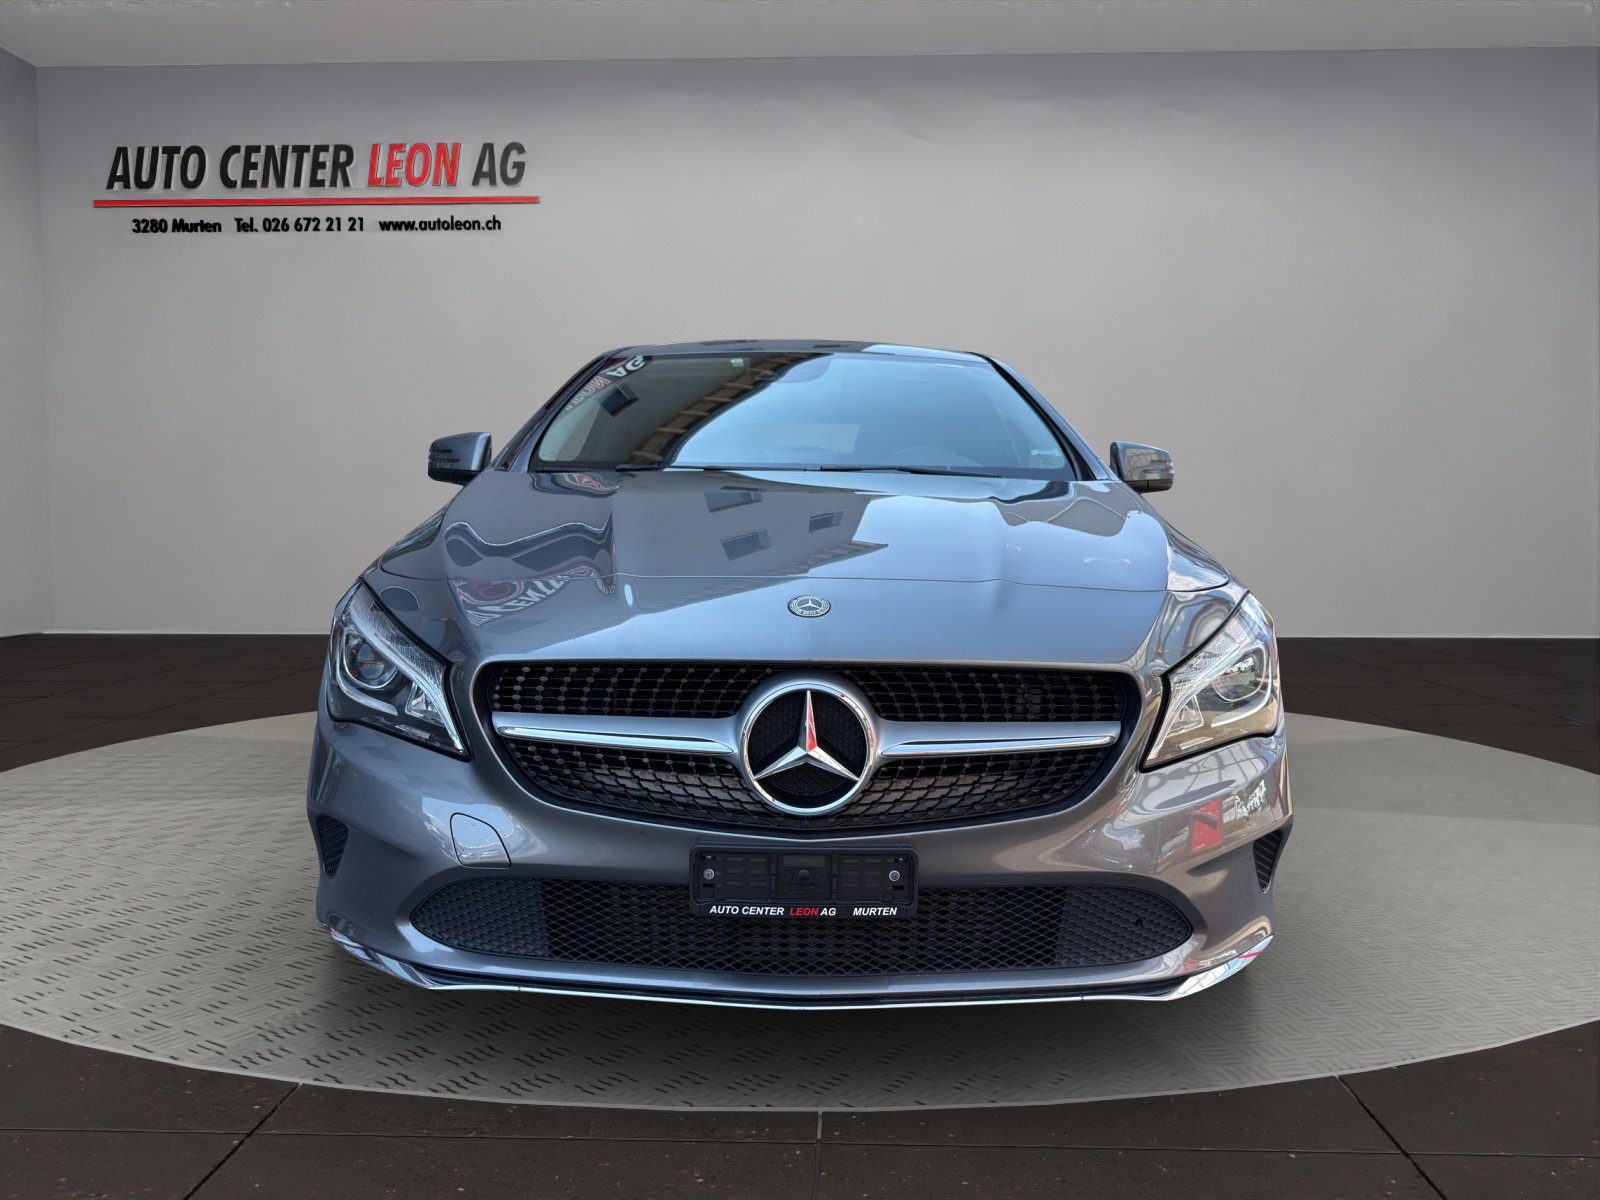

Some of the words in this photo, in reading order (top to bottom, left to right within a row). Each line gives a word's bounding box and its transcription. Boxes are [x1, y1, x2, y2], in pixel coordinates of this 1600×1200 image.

[106, 145, 206, 190] AUTO
[219, 144, 354, 189] CENTER
[367, 142, 462, 187] LEON
[472, 141, 527, 186] AG
[132, 219, 168, 233] 3280
[172, 218, 222, 233] Murten
[235, 218, 258, 232] Tel.
[262, 218, 290, 232] 026
[294, 217, 321, 232] 672
[325, 217, 342, 231] 21
[347, 217, 364, 231] 21
[379, 215, 502, 231] www.autoleon.ch
[709, 905, 739, 915] AUTO
[742, 906, 784, 916] CENTER
[789, 907, 819, 916] LEON
[820, 907, 837, 916] AG
[853, 907, 898, 916] MURTEN
